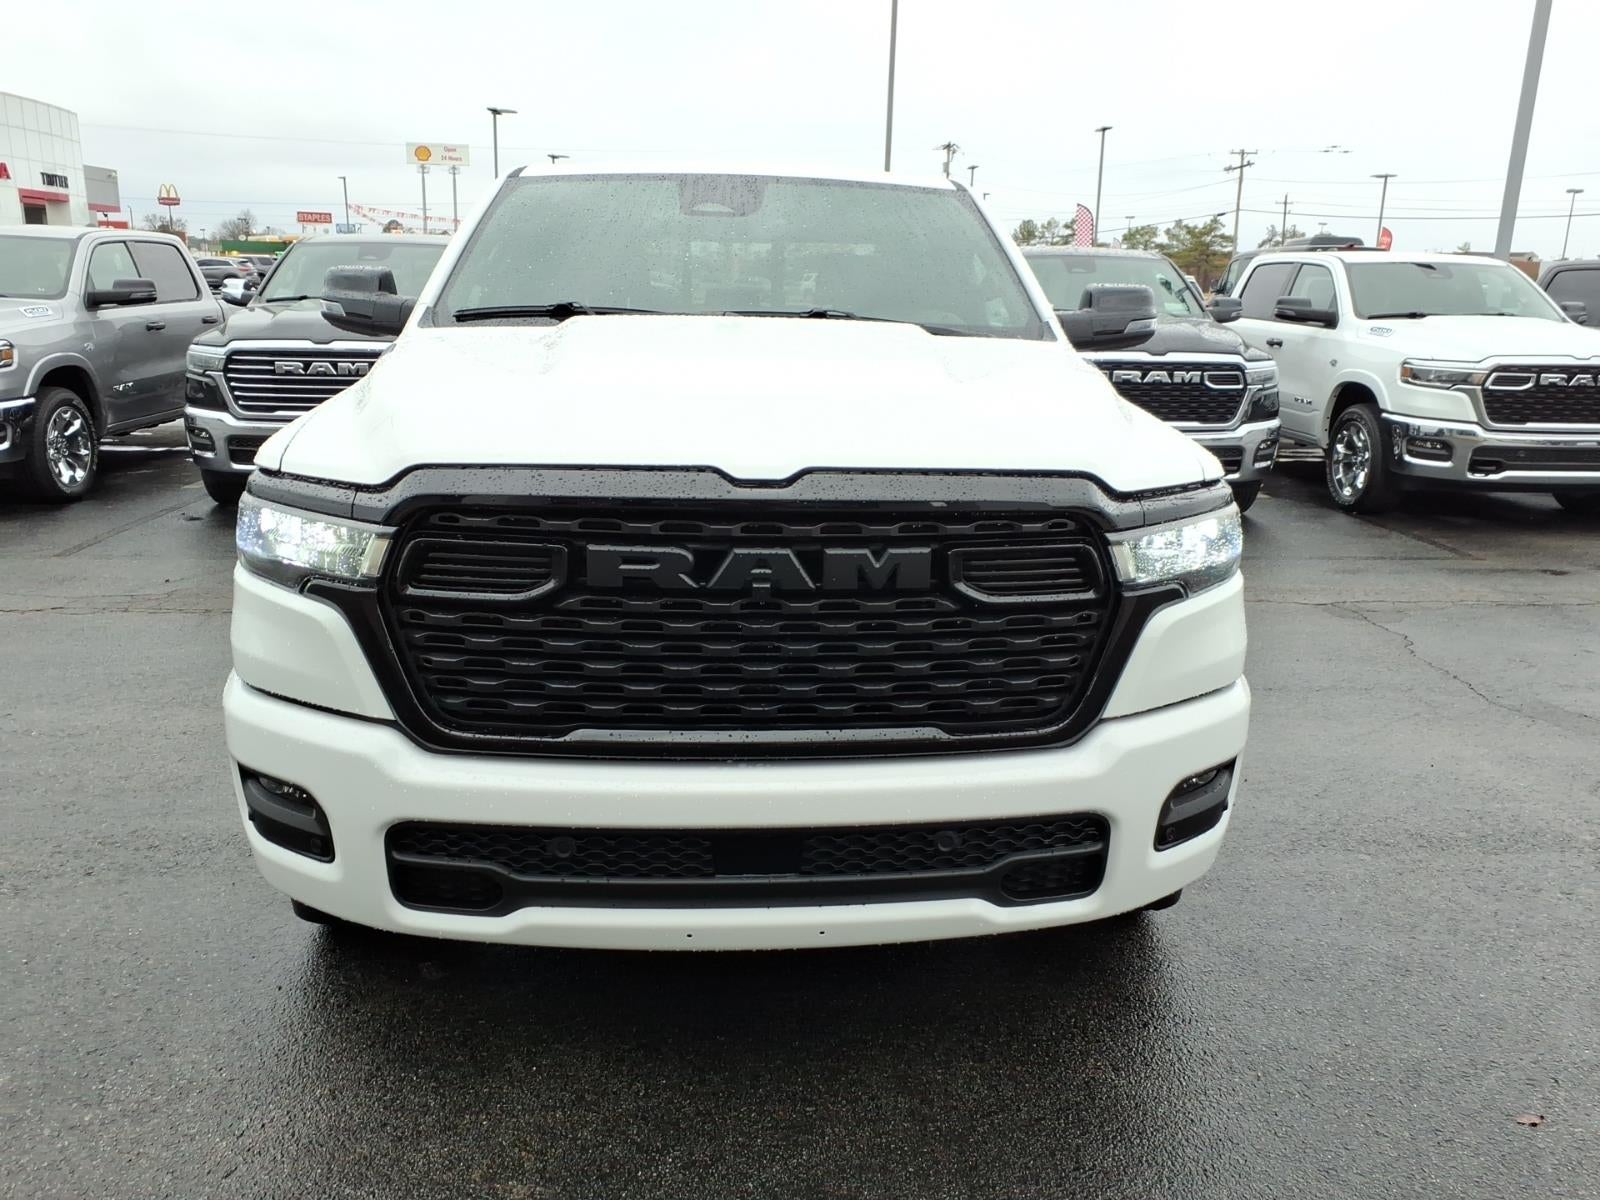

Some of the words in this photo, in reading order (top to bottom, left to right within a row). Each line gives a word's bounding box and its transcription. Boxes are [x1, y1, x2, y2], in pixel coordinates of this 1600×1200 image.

[298, 213, 330, 222] STAPLES
[274, 361, 369, 375] RAM
[1112, 370, 1202, 384] RAM
[1540, 373, 1600, 387] RA
[586, 544, 932, 589] RAM
